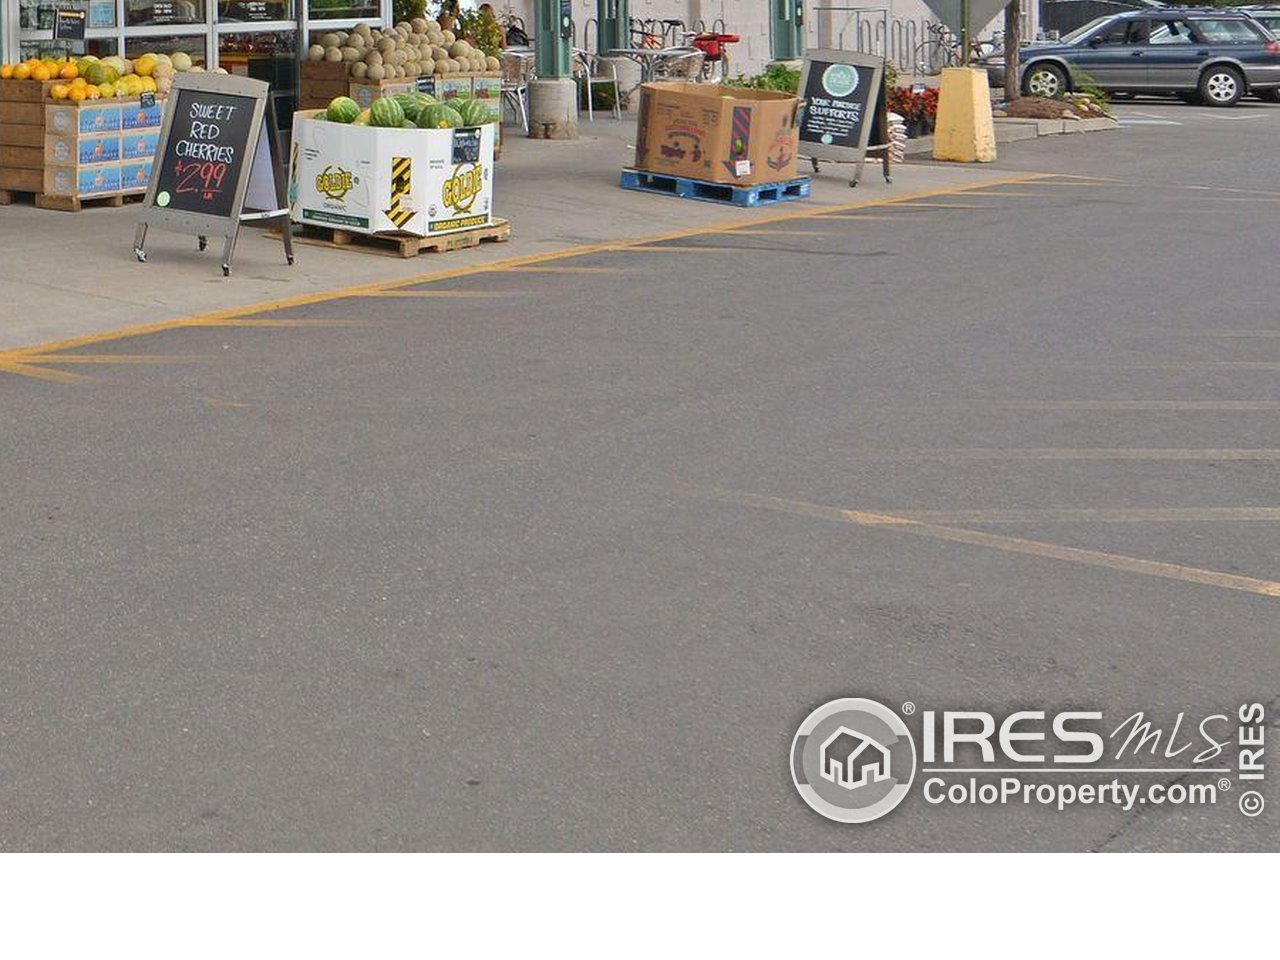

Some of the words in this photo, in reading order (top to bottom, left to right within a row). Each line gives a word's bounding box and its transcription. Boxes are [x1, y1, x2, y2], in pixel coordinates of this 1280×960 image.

[190, 102, 237, 121] SWEET
[809, 106, 860, 122] SUPPORTS
[190, 121, 220, 139] RED
[176, 140, 234, 164] CHERRIES
[315, 171, 353, 193] GOLDIE
[442, 162, 483, 209] GOLDIE
